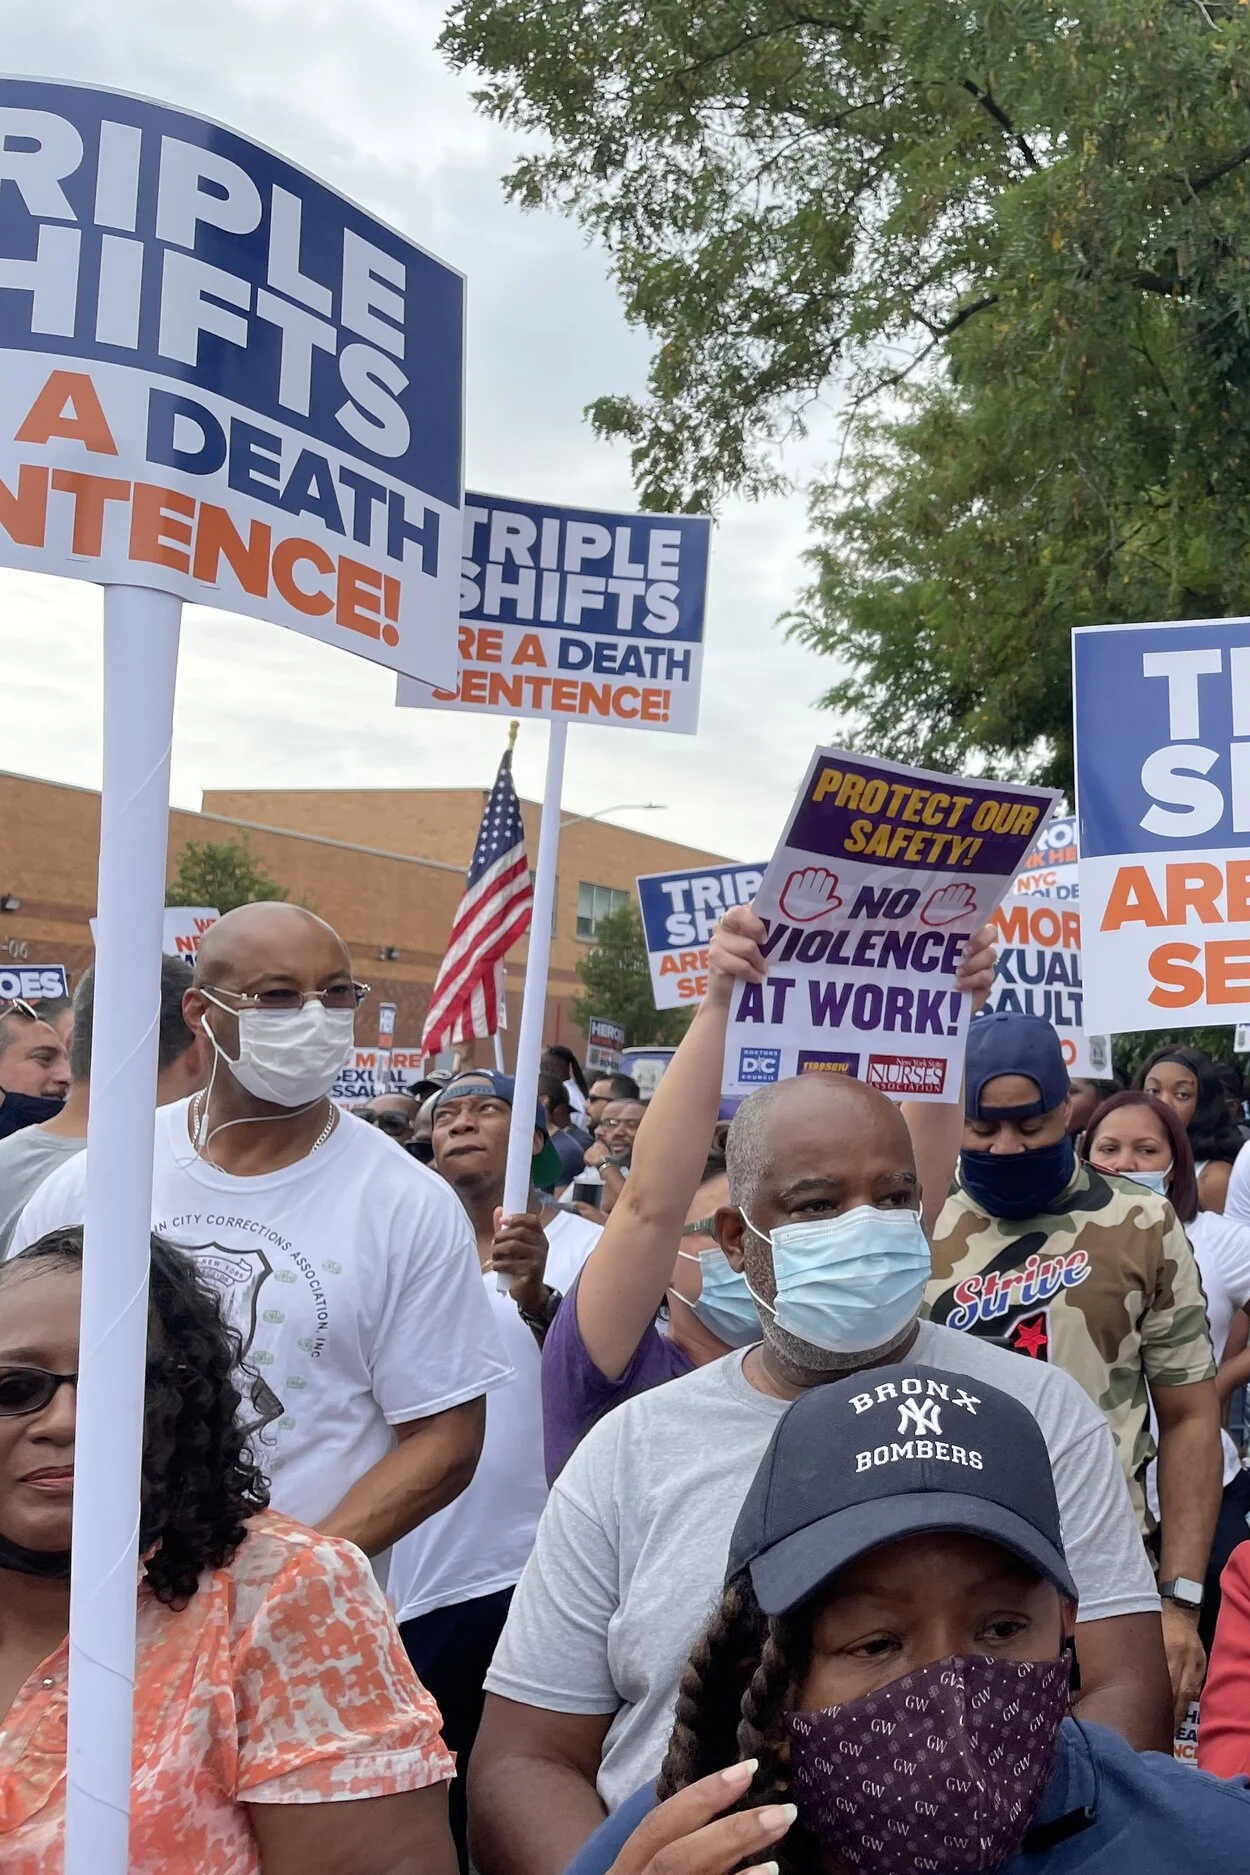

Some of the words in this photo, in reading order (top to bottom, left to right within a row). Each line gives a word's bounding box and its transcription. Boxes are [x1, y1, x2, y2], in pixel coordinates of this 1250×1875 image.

[0, 107, 406, 360] RIPLE
[14, 369, 119, 456] A
[146, 387, 439, 578] DEATH
[462, 505, 682, 581] TRIPLE
[459, 557, 680, 634] SHIFTS
[511, 633, 547, 668] A
[558, 637, 691, 682] DEATH
[812, 768, 974, 828] PROTECT
[971, 800, 1040, 836] OUR
[844, 819, 983, 865] SAFETY!
[1017, 871, 1057, 892] NYC
[848, 886, 921, 920] NO
[758, 916, 971, 975] VIOLENCE
[736, 977, 795, 1024] AT
[808, 979, 962, 1036] WORK!
[355, 1053, 421, 1068] MRE
[896, 1058, 911, 1066] New
[870, 1064, 943, 1085] NURSES
[172, 1214, 202, 1228] CITY
[206, 1214, 292, 1251] CORRECTIONS
[946, 1250, 1092, 1331] Strive
[848, 1378, 982, 1415] BRONX
[897, 1398, 943, 1436] NY
[855, 1440, 983, 1473] BOMBERS
[905, 1695, 929, 1712] GW
[971, 1687, 991, 1710] GW
[1002, 1699, 1021, 1722] GW
[792, 1717, 812, 1736] GW
[871, 1718, 896, 1736] GW
[839, 1740, 863, 1757] GW
[927, 1735, 948, 1754] GW
[814, 1757, 834, 1776] GW
[893, 1758, 917, 1776] GW
[1013, 1753, 1032, 1777] GW
[862, 1780, 886, 1799] GW
[946, 1777, 971, 1793] GW
[836, 1797, 858, 1815] GW
[914, 1800, 939, 1817] GW
[887, 1819, 910, 1837] GW
[861, 1835, 884, 1852] GW
